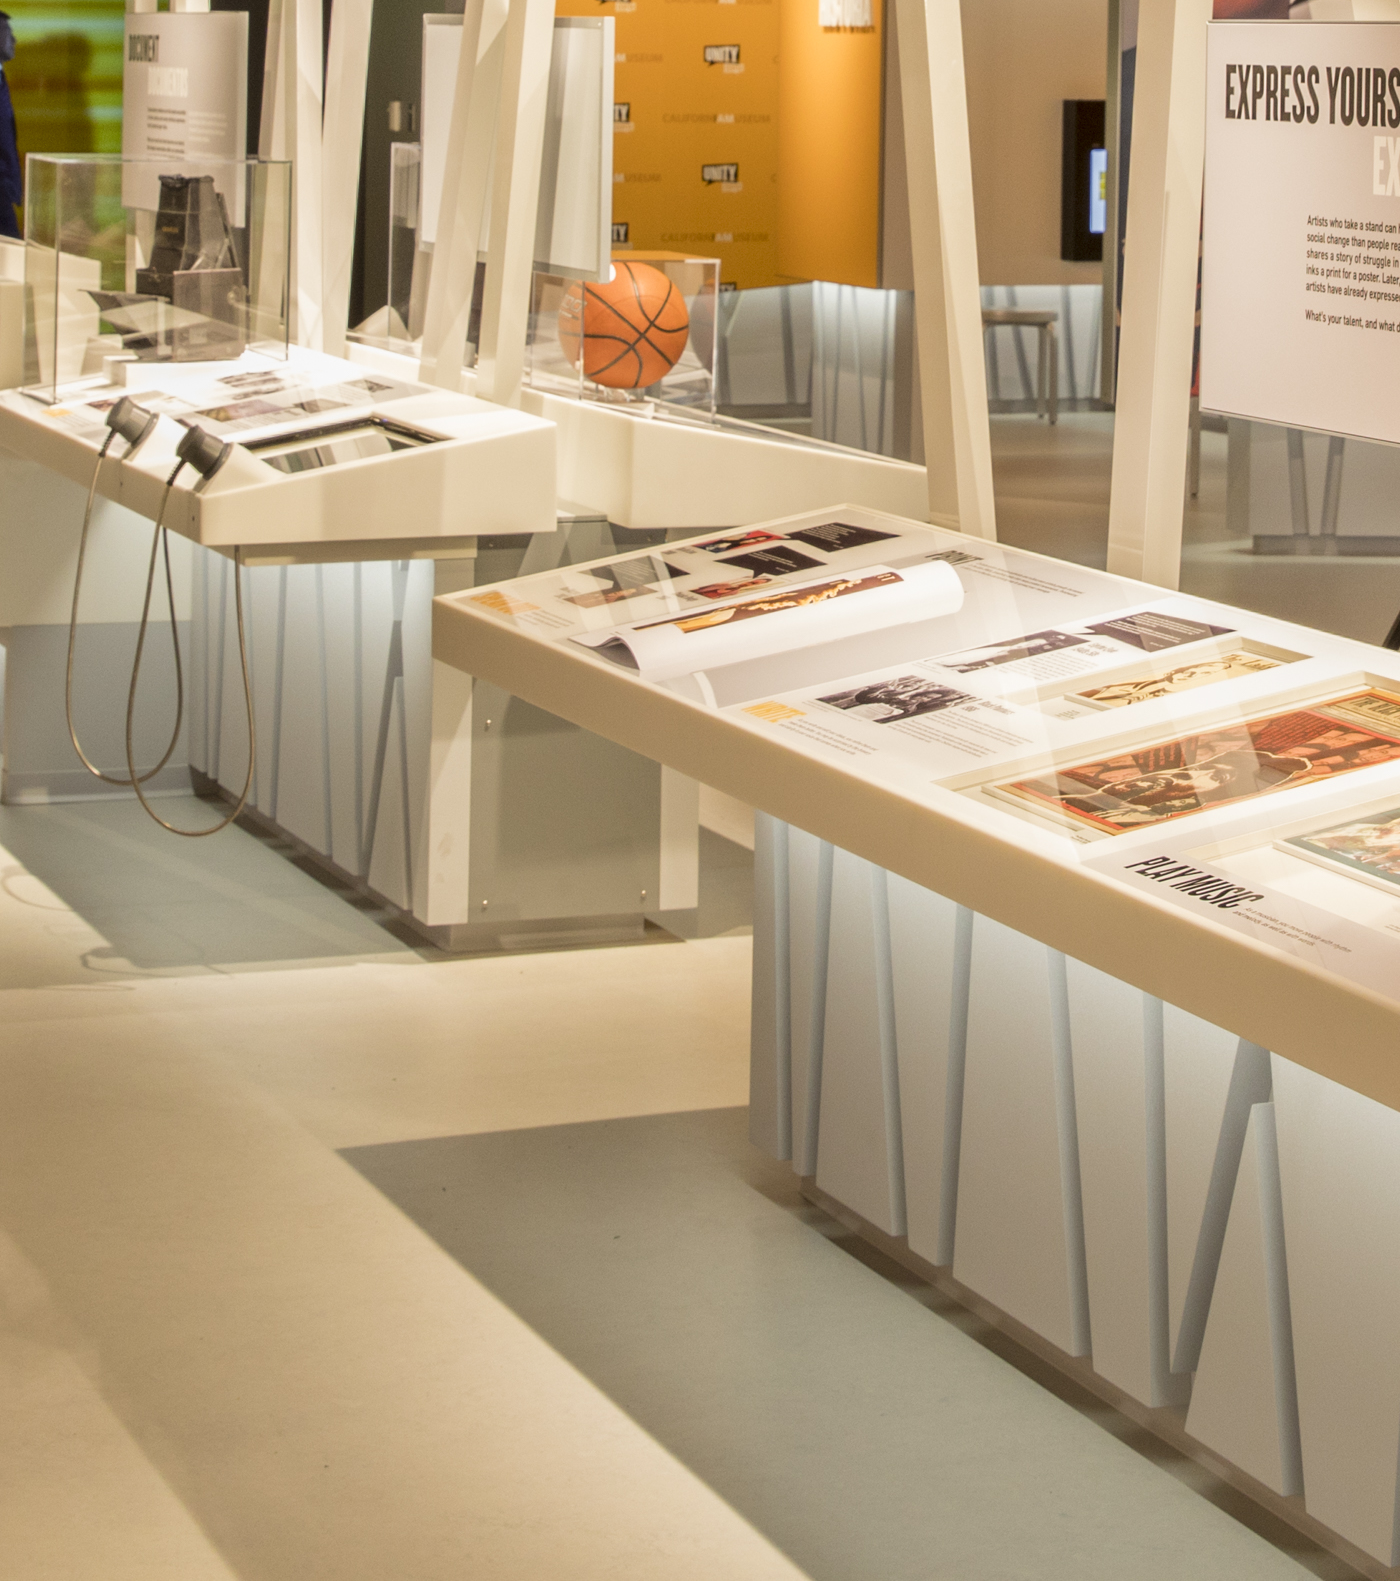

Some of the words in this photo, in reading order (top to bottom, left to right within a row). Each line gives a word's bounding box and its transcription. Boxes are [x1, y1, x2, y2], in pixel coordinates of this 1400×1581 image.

[1225, 64, 1320, 124] EXPRESS
[1305, 310, 1326, 322] What's
[1328, 315, 1342, 325] your
[1343, 315, 1364, 328] talent,
[1365, 319, 1377, 330] and
[1379, 320, 1395, 332] what
[1124, 855, 1197, 882] PLAY
[1169, 869, 1265, 909] MUSIC
